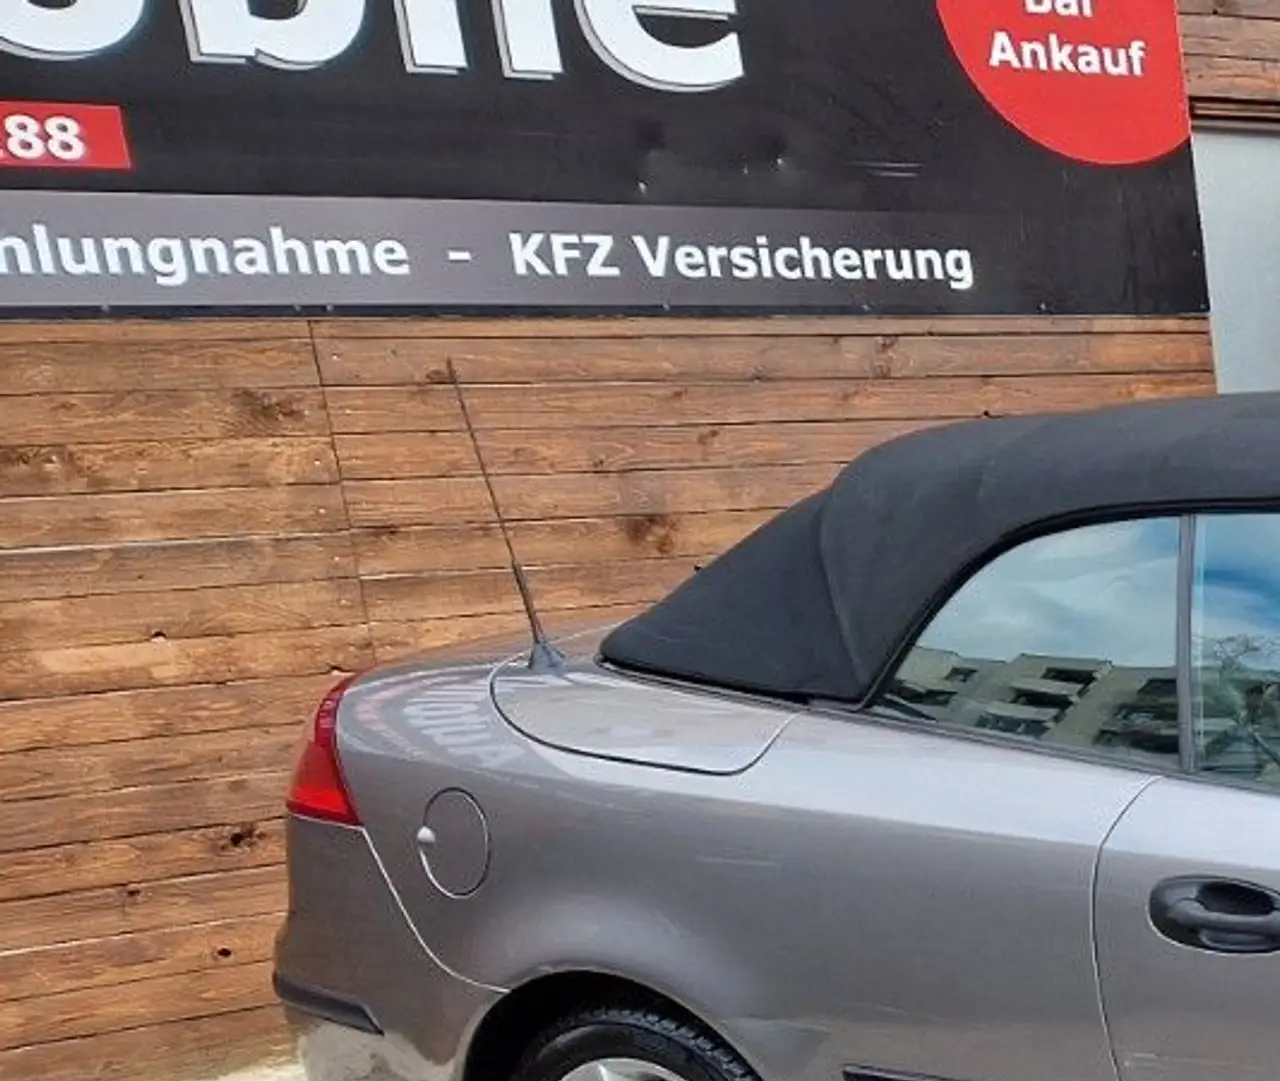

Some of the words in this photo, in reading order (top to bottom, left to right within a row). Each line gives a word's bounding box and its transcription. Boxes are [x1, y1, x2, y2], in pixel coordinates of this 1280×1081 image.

[989, 31, 1145, 76] Ankauf
[0, 114, 85, 160] 88
[509, 232, 621, 277] KFZ
[631, 236, 974, 290] Versicherung
